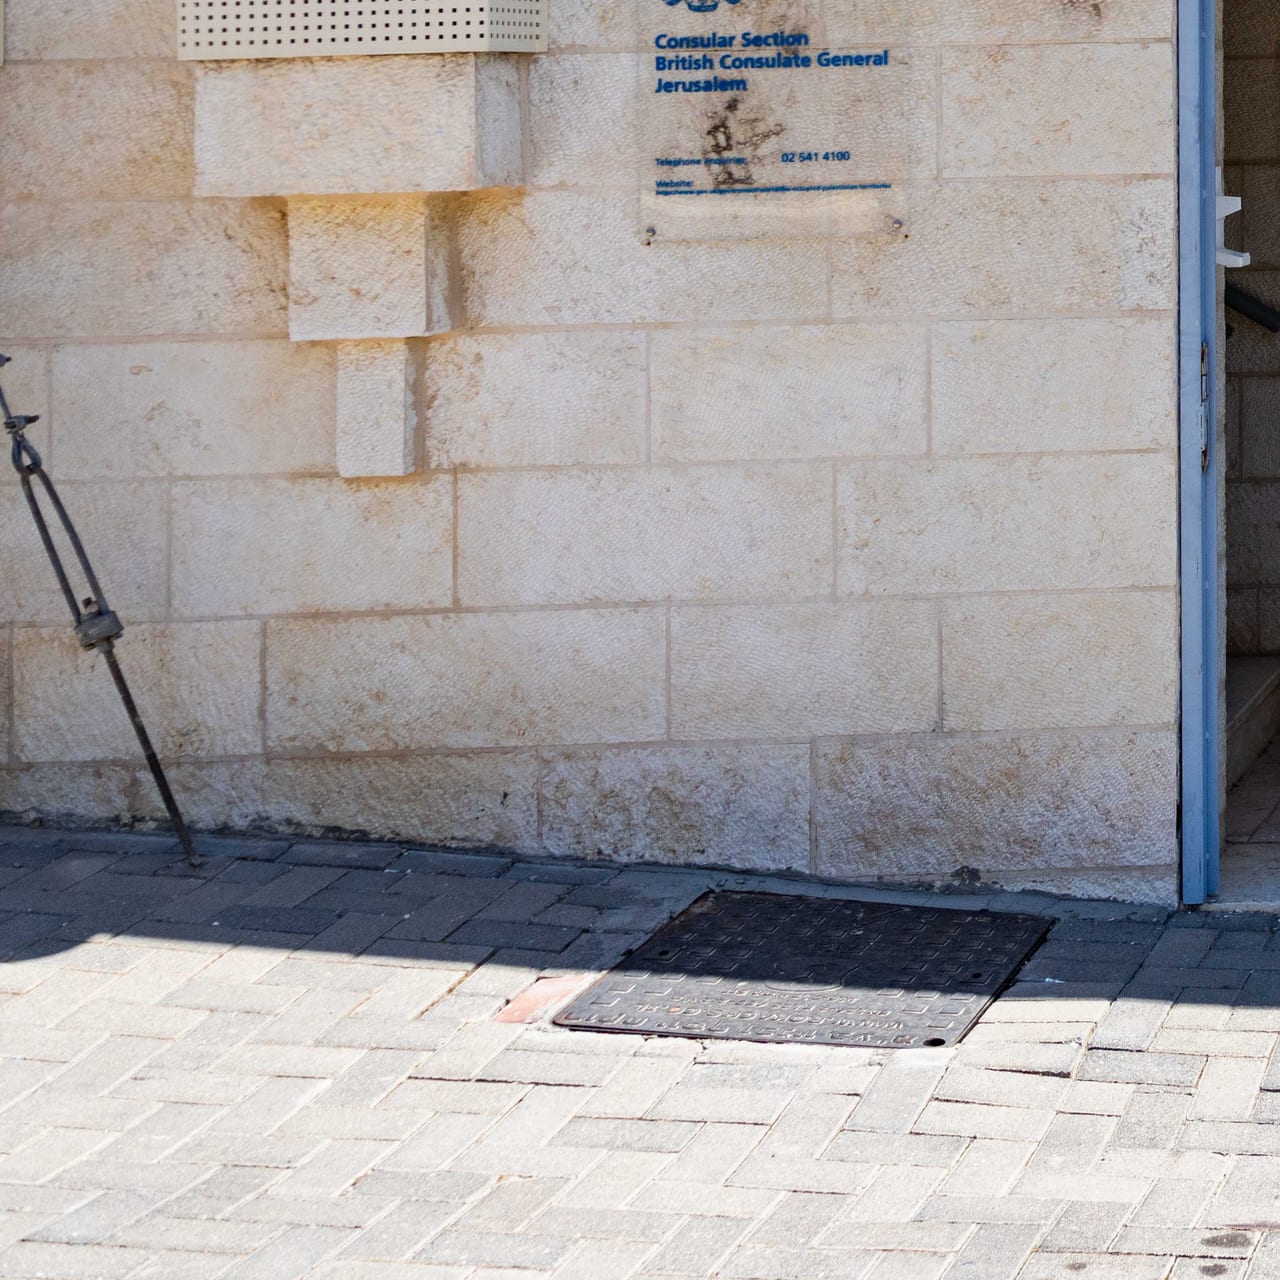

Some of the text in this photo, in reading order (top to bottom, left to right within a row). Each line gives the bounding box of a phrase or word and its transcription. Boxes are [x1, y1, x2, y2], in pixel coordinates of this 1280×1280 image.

[655, 31, 809, 50] Consular Section
[655, 50, 889, 71] British Consulate General
[655, 76, 748, 94] Jerusalem
[655, 157, 702, 168] Telephone
[781, 152, 795, 163] 02
[800, 152, 818, 163] 541
[823, 150, 851, 162] 4100
[655, 179, 694, 189] Website:
